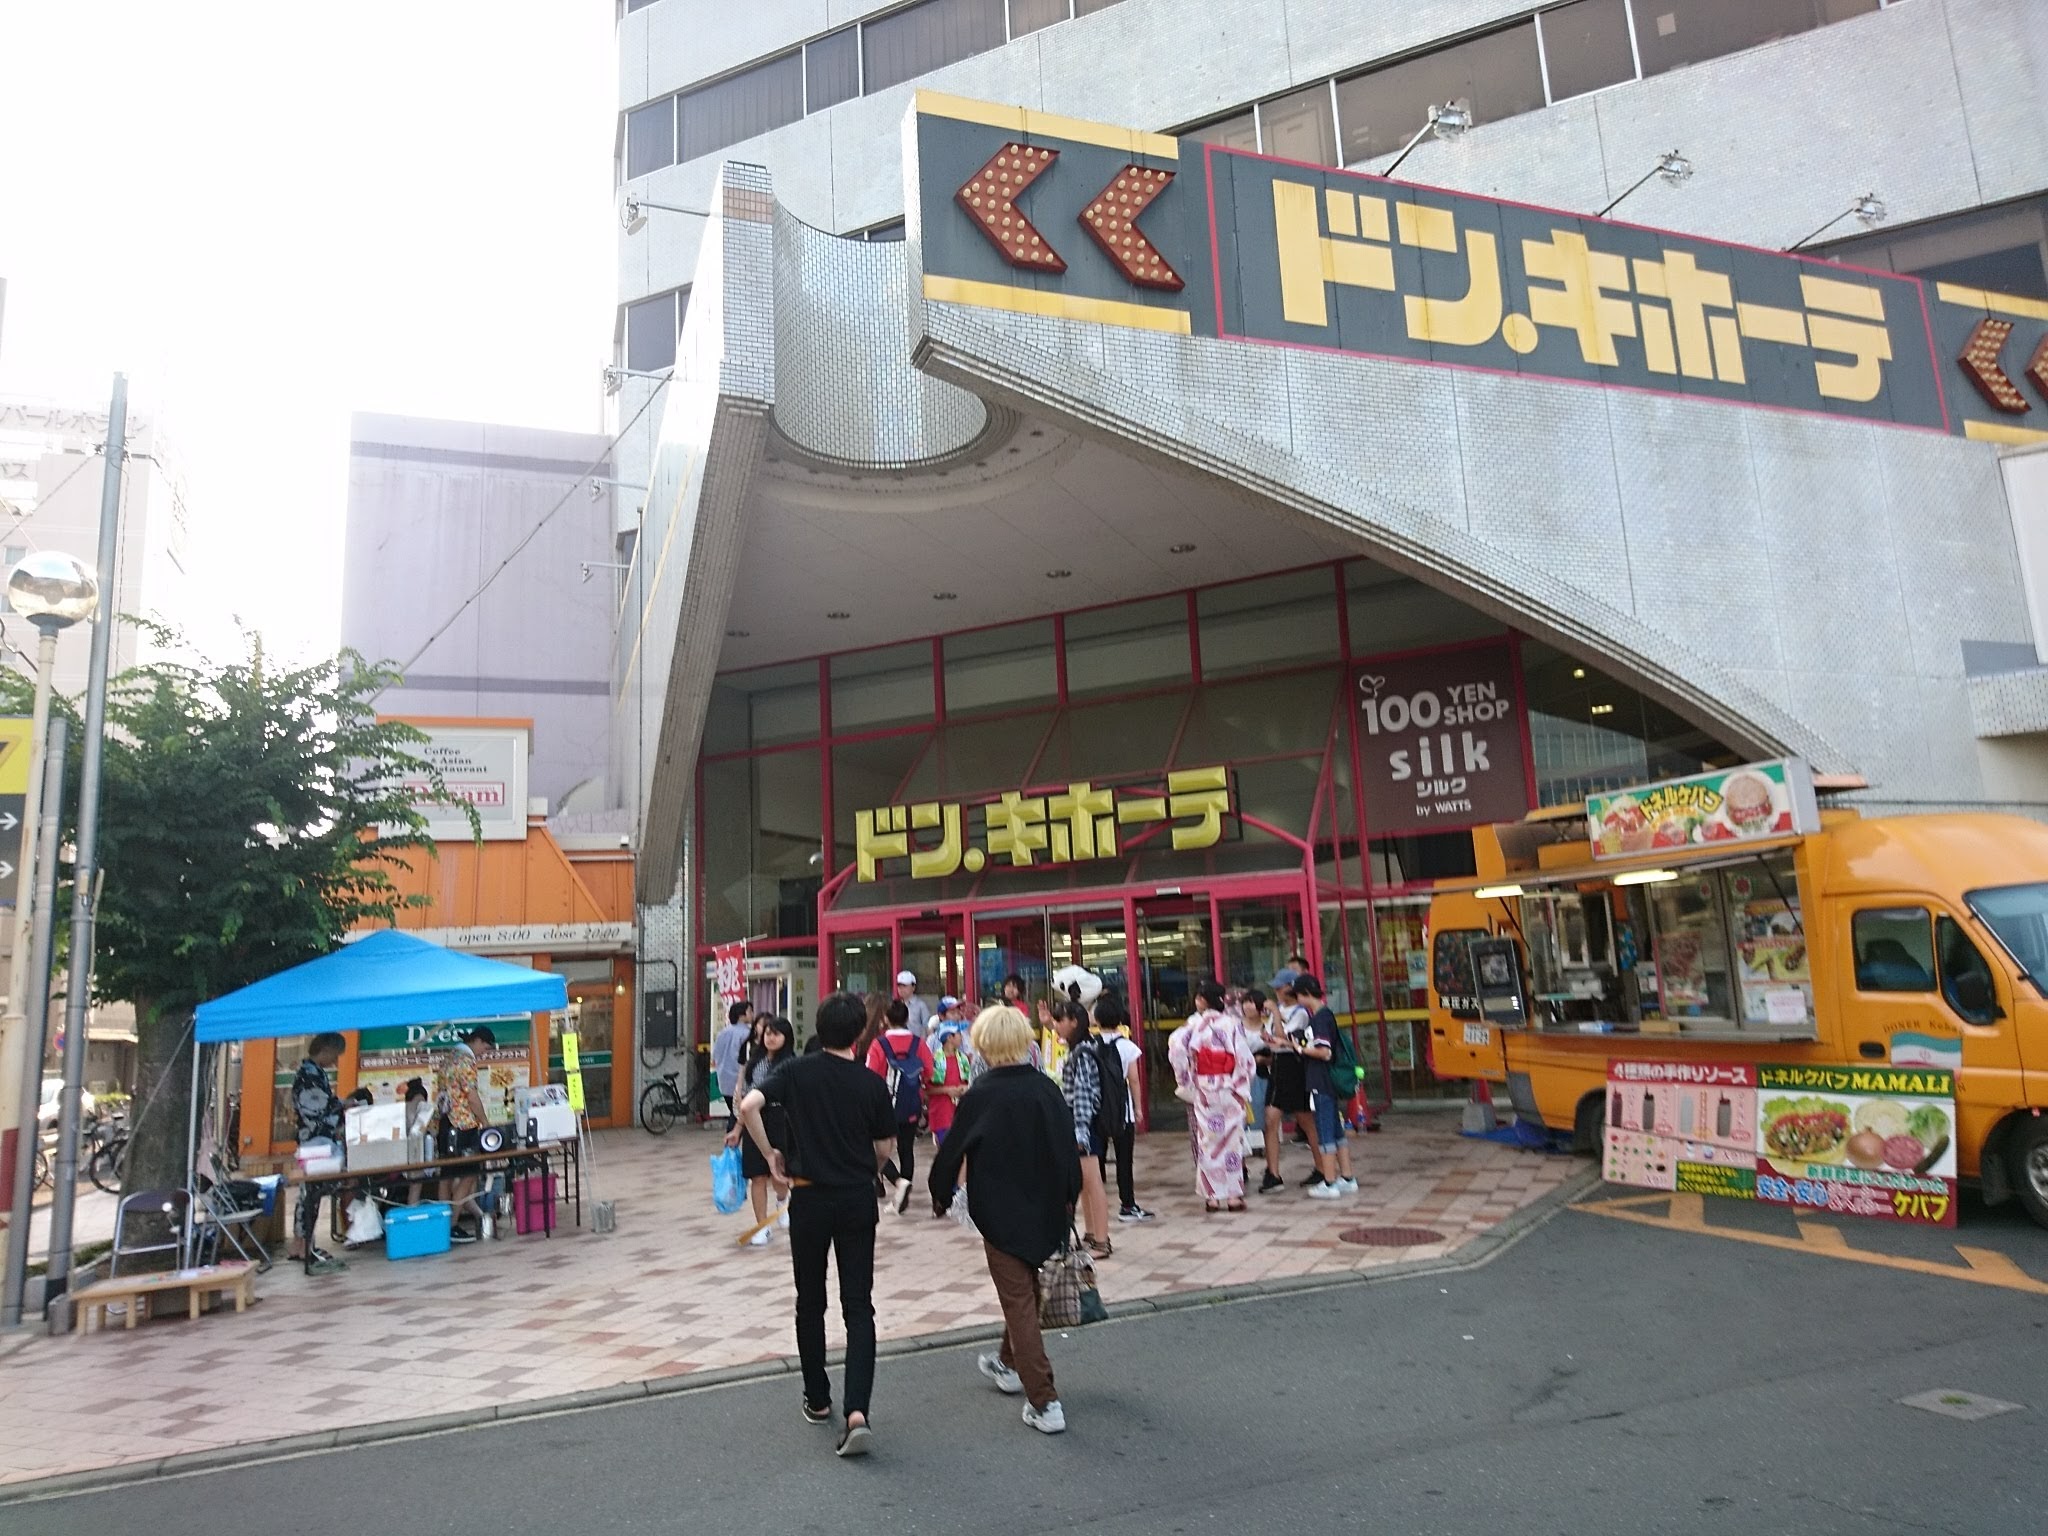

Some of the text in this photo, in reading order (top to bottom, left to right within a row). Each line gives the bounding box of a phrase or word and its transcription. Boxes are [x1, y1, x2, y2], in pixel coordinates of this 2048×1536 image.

[1447, 681, 1496, 705] YEN
[1361, 690, 1441, 735] 100
[1443, 699, 1510, 726] SHOP
[424, 747, 461, 755] Coffee
[440, 757, 472, 765] Asian
[1389, 731, 1490, 781] silk
[1416, 776, 1467, 799] シルク
[1415, 799, 1472, 818] by WATTS
[458, 932, 491, 945] open
[497, 930, 531, 940] 8:00
[542, 928, 577, 939] close
[1850, 1071, 1951, 1094] MAMALI
